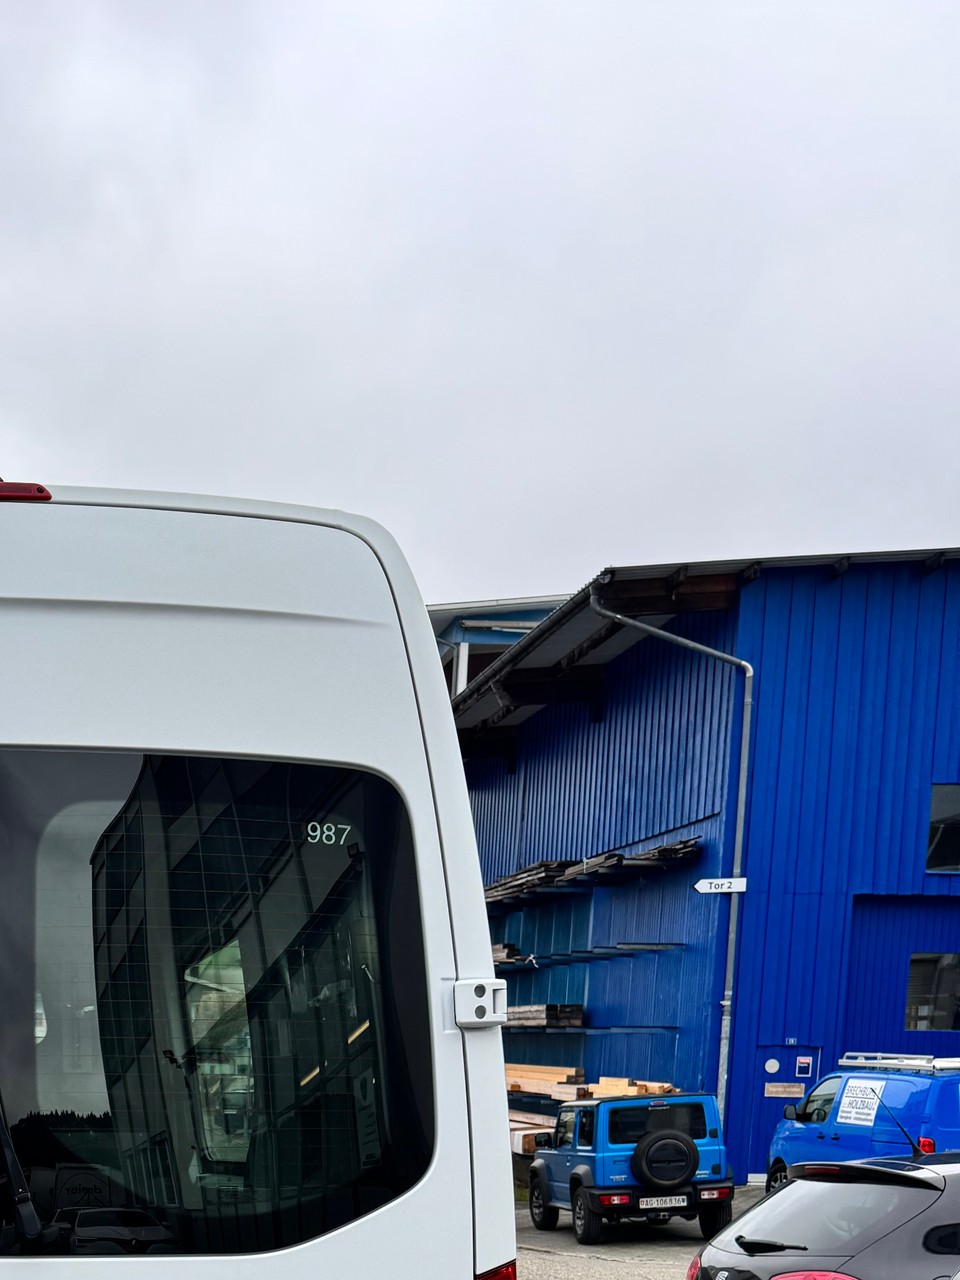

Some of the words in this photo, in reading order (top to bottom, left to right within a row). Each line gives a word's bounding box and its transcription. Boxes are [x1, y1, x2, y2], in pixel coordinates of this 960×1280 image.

[307, 822, 351, 845] 987
[708, 881, 725, 890] Tor
[727, 881, 733, 890] 2
